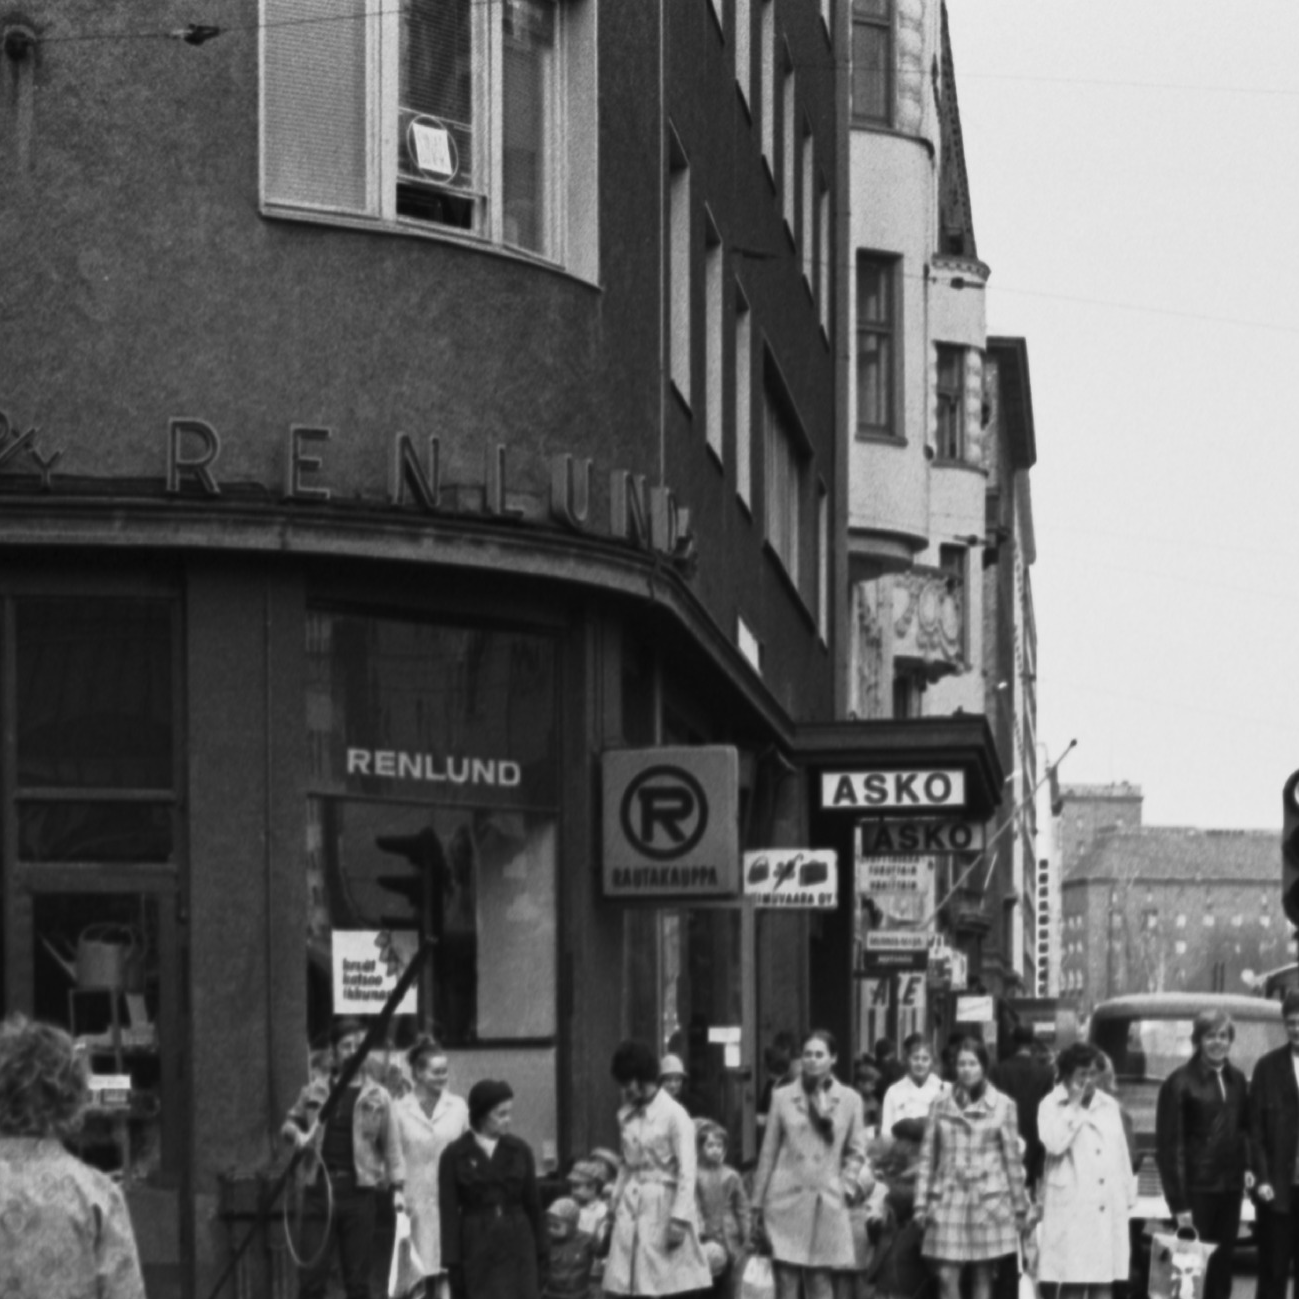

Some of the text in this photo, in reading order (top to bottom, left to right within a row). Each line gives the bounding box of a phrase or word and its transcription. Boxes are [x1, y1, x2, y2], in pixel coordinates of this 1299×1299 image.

[347, 748, 521, 786] RENLUND
[832, 772, 952, 805] ASKO
[875, 823, 973, 850] ASKO
[612, 867, 718, 887] RAUTAKAUPPA
